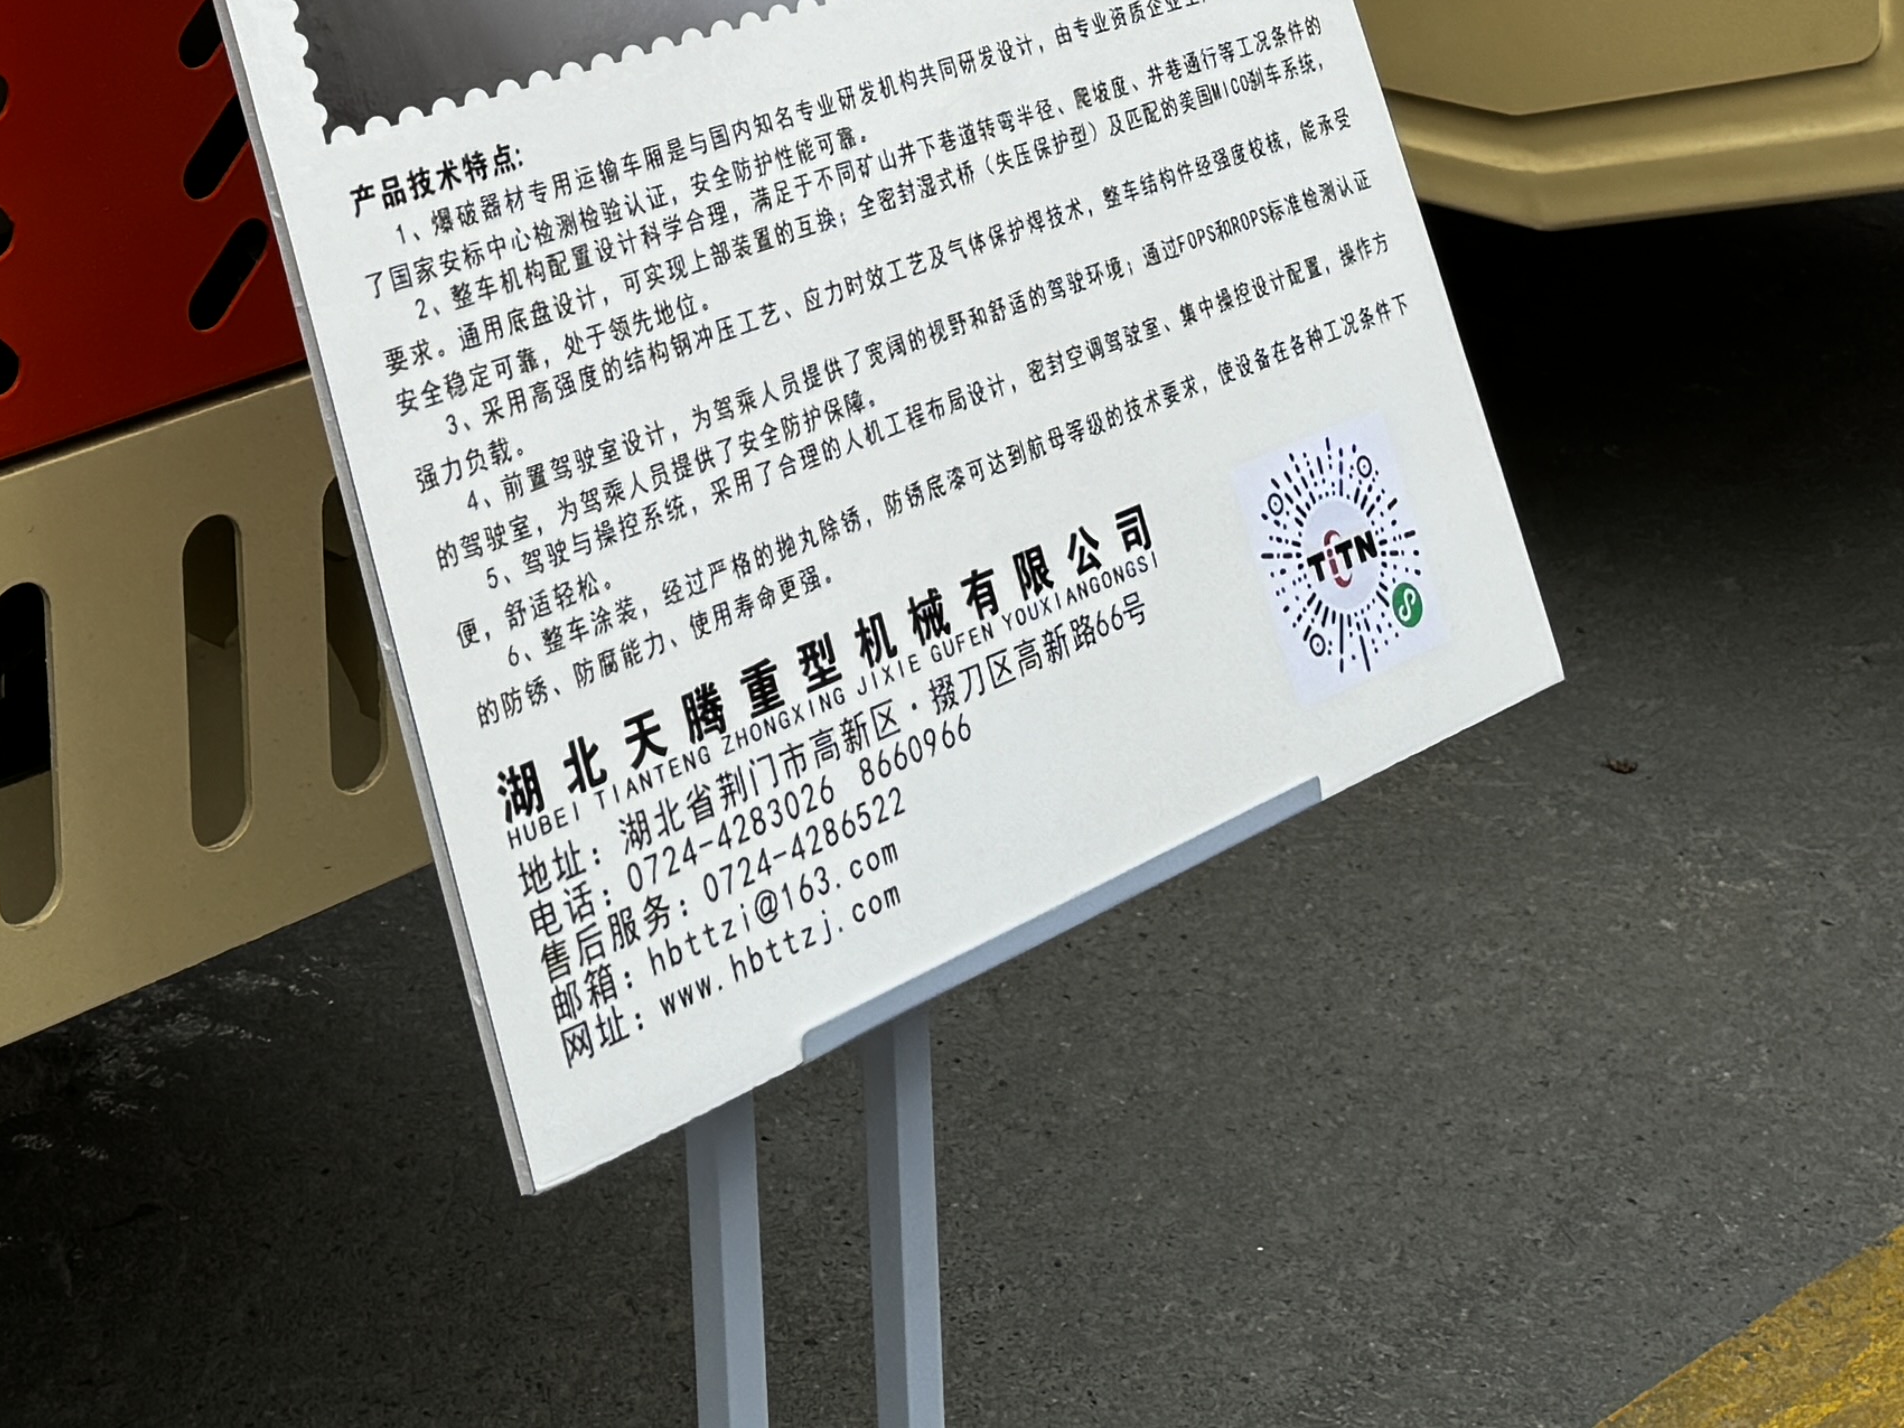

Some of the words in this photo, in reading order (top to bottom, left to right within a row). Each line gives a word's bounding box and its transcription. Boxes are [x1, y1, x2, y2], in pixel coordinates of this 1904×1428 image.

[349, 143, 522, 217] 产品技术特点:
[365, 126, 865, 298] 了国家安标中心检测检验认证，安全防护性能可靠。
[395, 293, 708, 416] 安全稳定可靠，处于领先地位。
[414, 437, 523, 493] 强力负载。
[435, 389, 874, 570] 的驾驶室，为驾乘人员提供了安全防护保障。
[456, 571, 610, 648] 便，舒适轻松。
[476, 565, 831, 727] 的防锈、防腐能力、使用寿命更强。
[497, 503, 1151, 823] 湖北天腾重型机械有限公司
[507, 801, 579, 849] HUBEI
[593, 745, 710, 809] TIANTENG
[719, 687, 845, 755] ZHONGXING
[857, 653, 921, 695] JIXIE
[930, 621, 993, 662] GUFEN
[1001, 547, 1157, 630] YOUXIANGONGSI
[859, 712, 970, 785] 8660966
[540, 786, 905, 983] 售后服务：0724-4286522
[560, 885, 900, 1068] 网址：www.hbttzj.com
